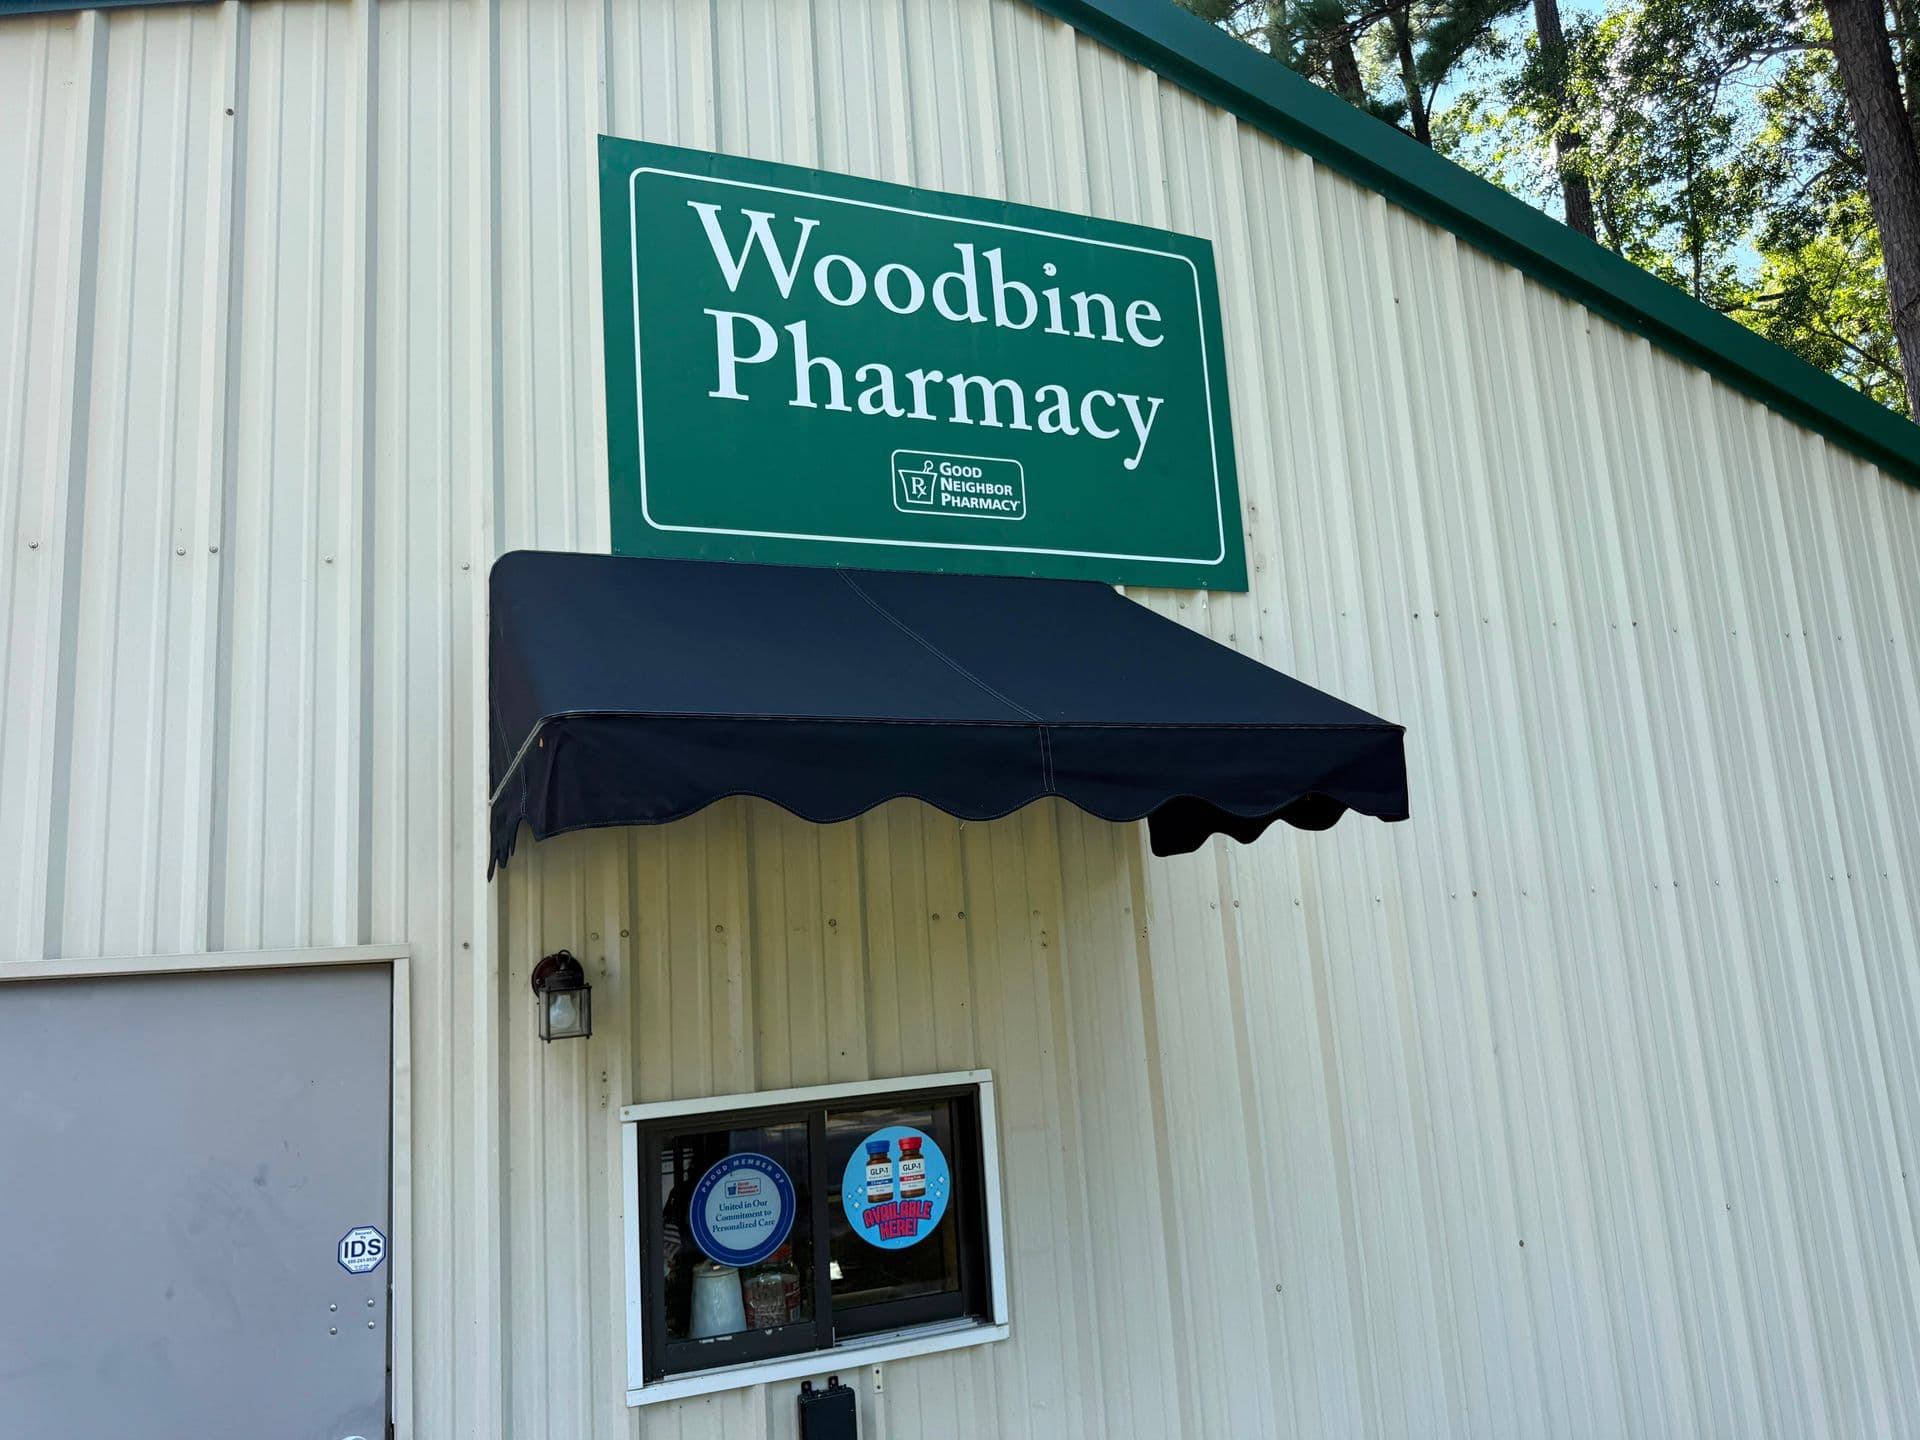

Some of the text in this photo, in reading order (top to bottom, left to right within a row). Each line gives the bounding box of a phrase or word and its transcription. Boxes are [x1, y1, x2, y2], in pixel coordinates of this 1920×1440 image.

[687, 200, 1165, 348] Woodbine
[703, 308, 1165, 471] Pharmacy
[939, 462, 983, 479] GOOD
[940, 477, 1013, 496] NEIGHBOR
[941, 492, 1019, 512] PHARMACY
[701, 1165, 728, 1193] PROUD
[733, 1158, 773, 1172] MEMBER
[870, 1167, 889, 1176] GLP-1
[902, 1162, 921, 1172] GLP-1
[719, 1199, 768, 1212] United in Our
[863, 1199, 933, 1229] AVAILABLE
[712, 1217, 775, 1233] Personalized Care
[715, 1209, 772, 1222] Commitment to
[880, 1217, 919, 1241] HERE!
[344, 1238, 381, 1259] IDS
